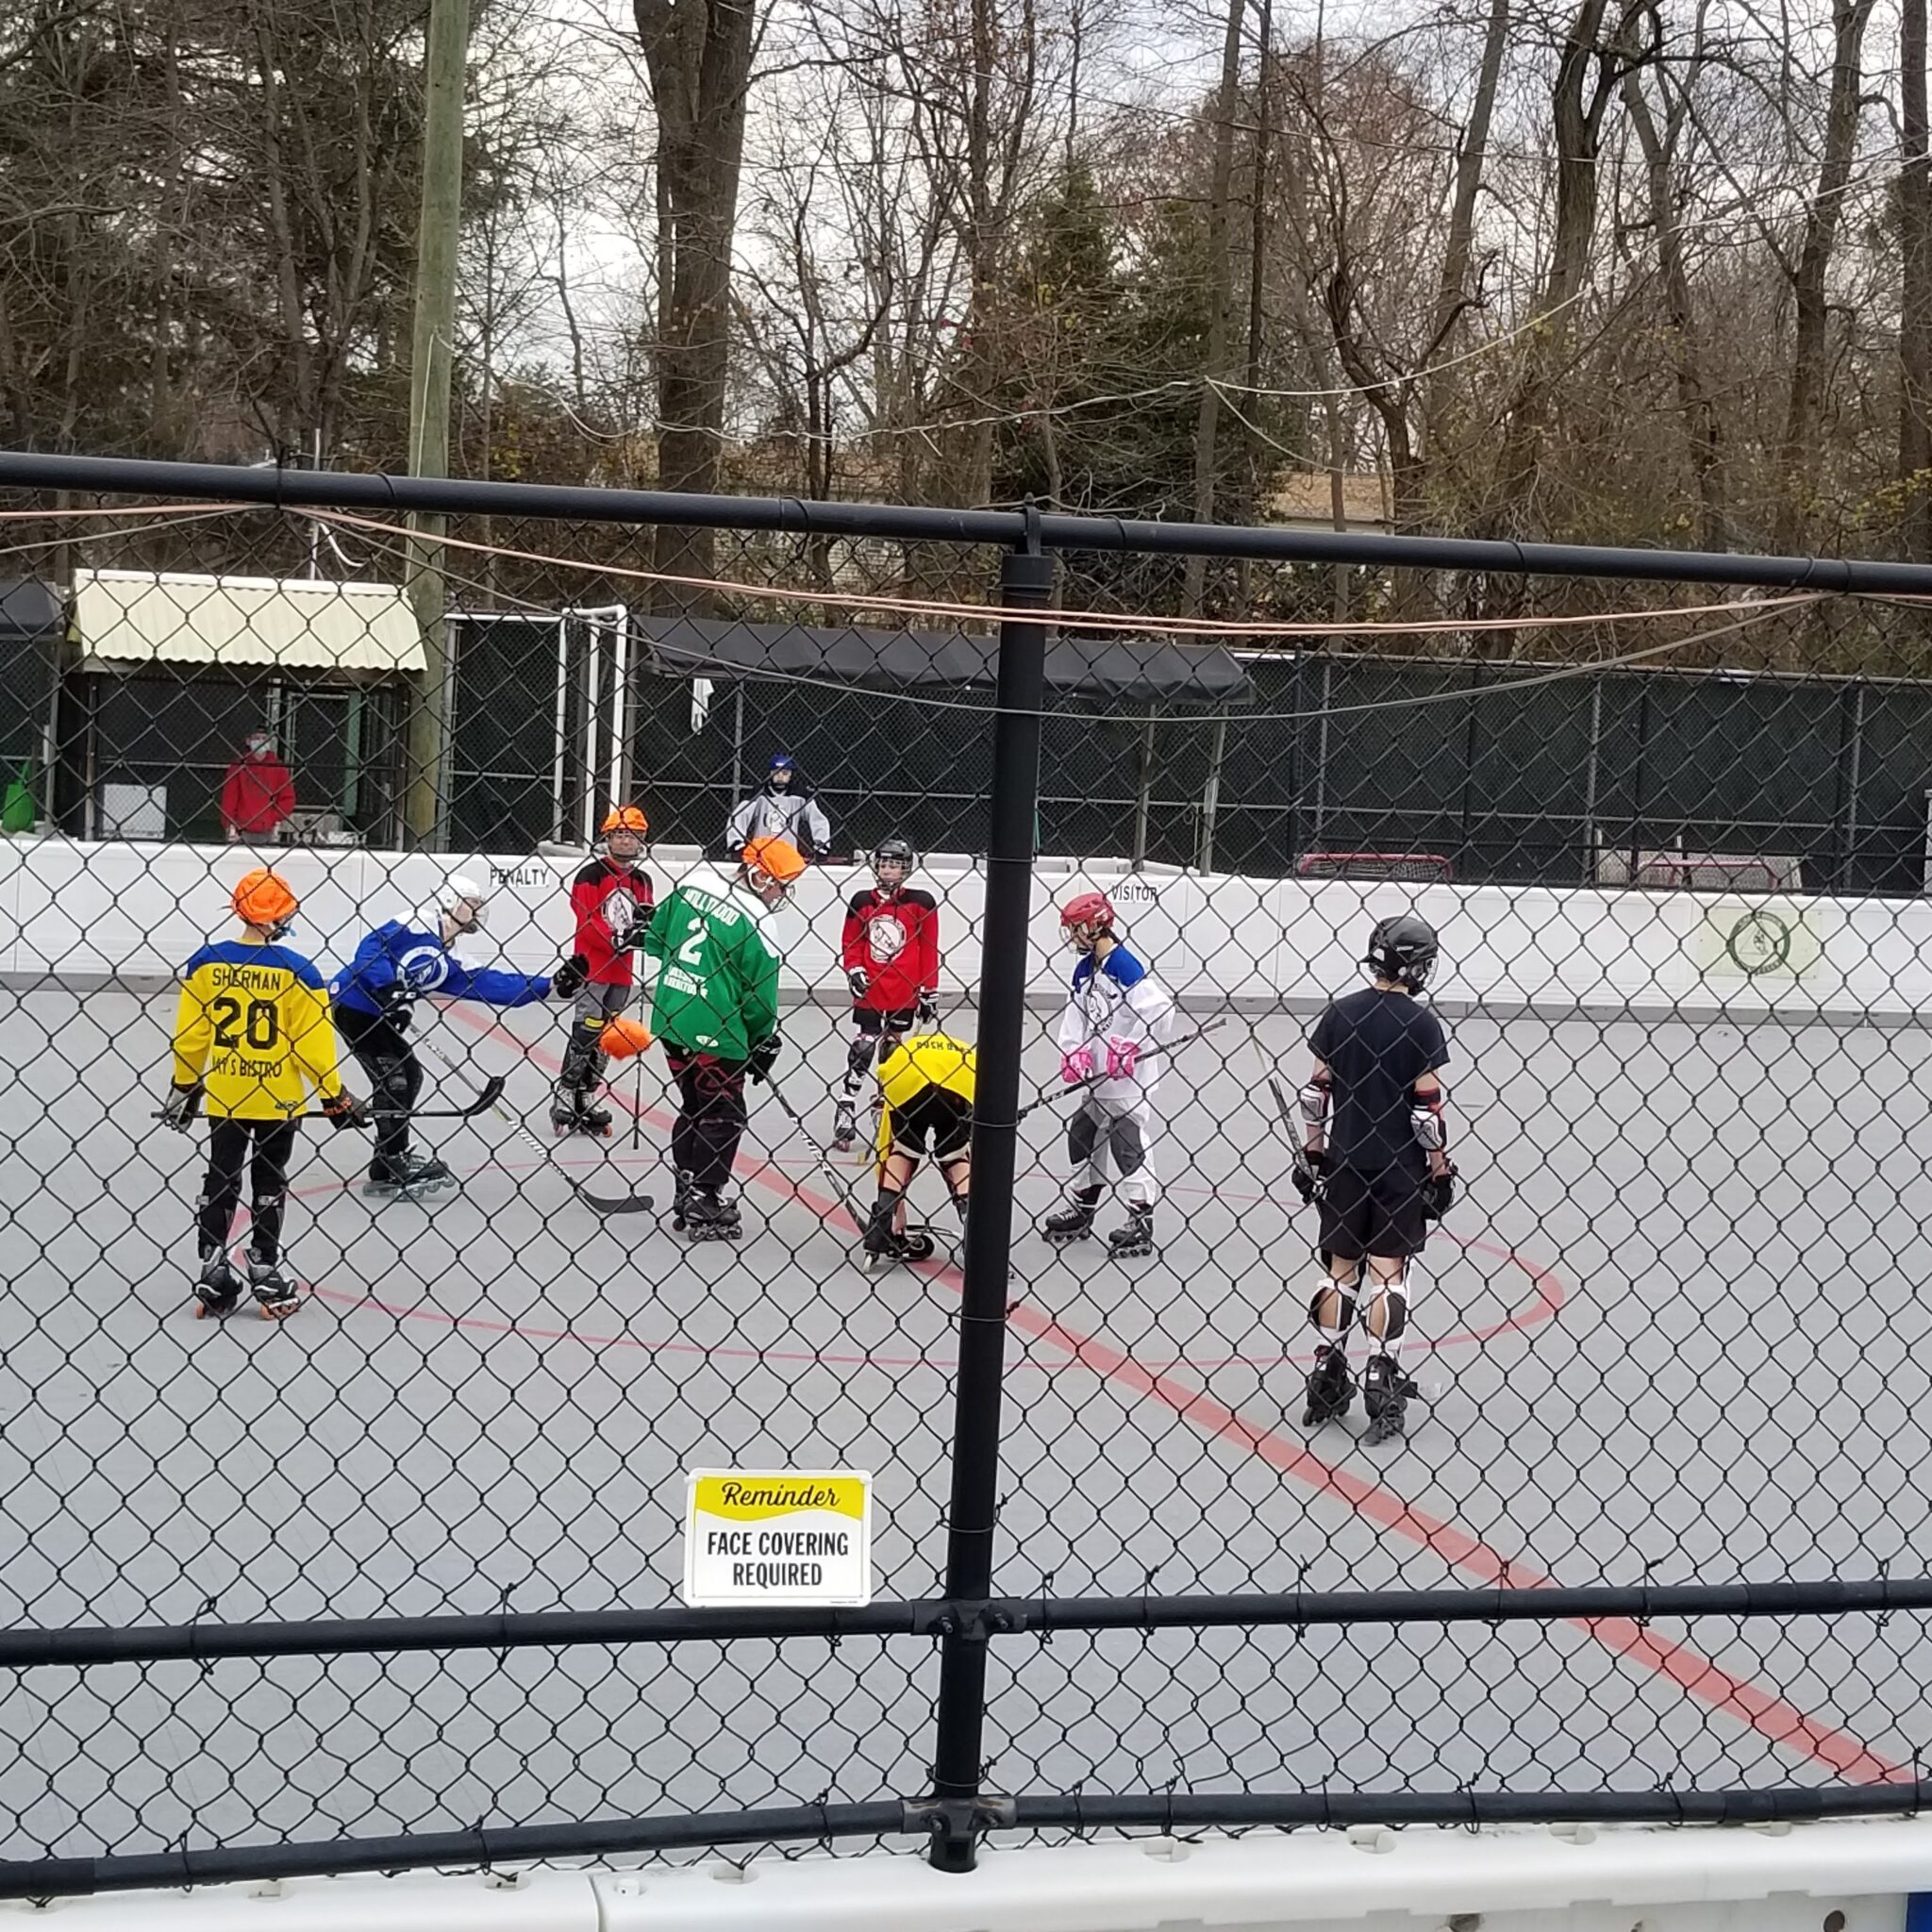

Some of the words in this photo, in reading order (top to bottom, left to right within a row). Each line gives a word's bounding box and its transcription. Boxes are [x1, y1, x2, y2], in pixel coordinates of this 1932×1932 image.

[490, 868, 549, 885] PENALTY
[1112, 885, 1158, 901] VISITOR
[678, 917, 709, 966] 2
[211, 967, 281, 991] SHERMAN
[213, 997, 278, 1050] 20
[240, 1059, 282, 1079] BISTRO
[722, 1482, 841, 1507] Reminder
[708, 1532, 752, 1556] FACE
[758, 1532, 848, 1556] COVERING
[733, 1562, 822, 1589] REQUIRED
